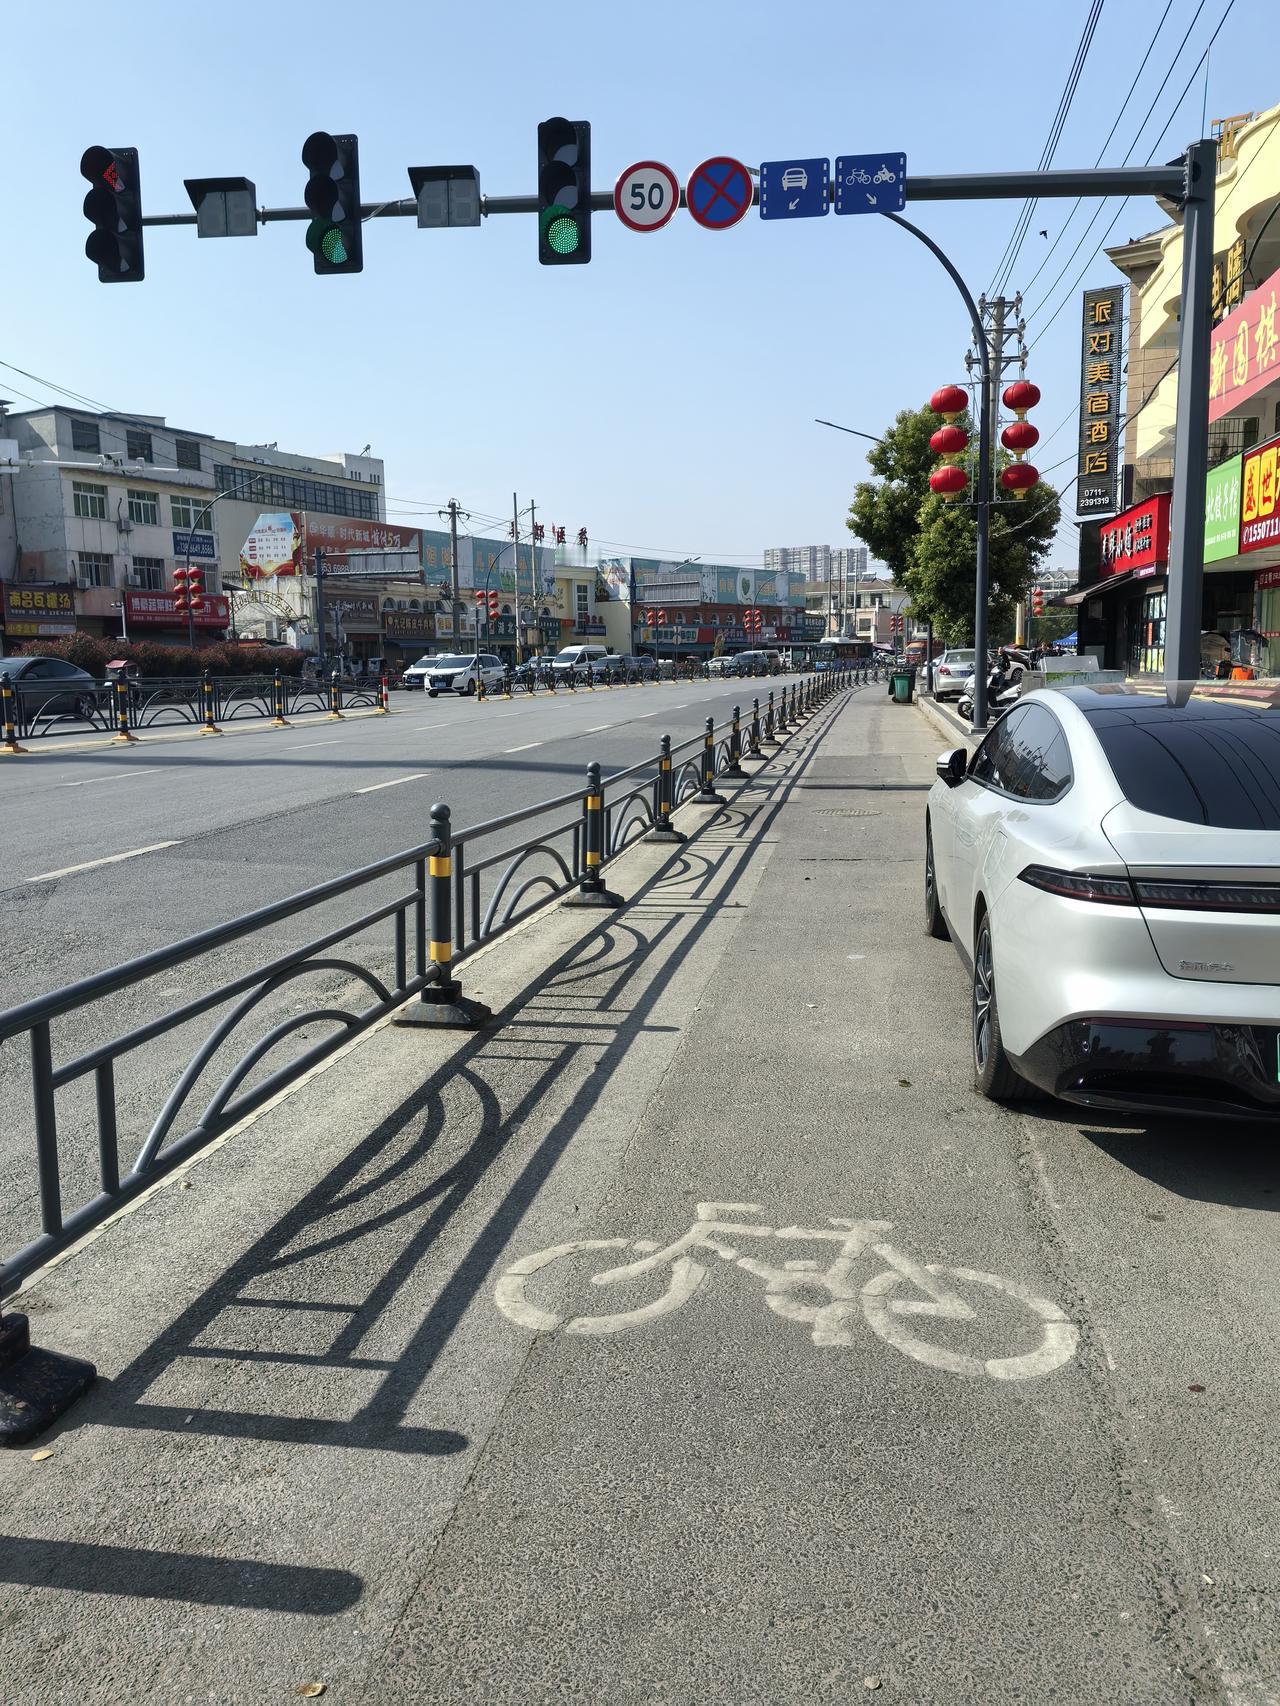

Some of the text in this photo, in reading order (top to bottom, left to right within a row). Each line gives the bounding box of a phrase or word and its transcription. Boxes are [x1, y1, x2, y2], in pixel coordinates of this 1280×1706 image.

[630, 182, 664, 211] 50
[1084, 299, 1112, 475] 派对美宿酒店
[1080, 496, 1109, 507] 2391319
[1248, 517, 1280, 543] 1550711
